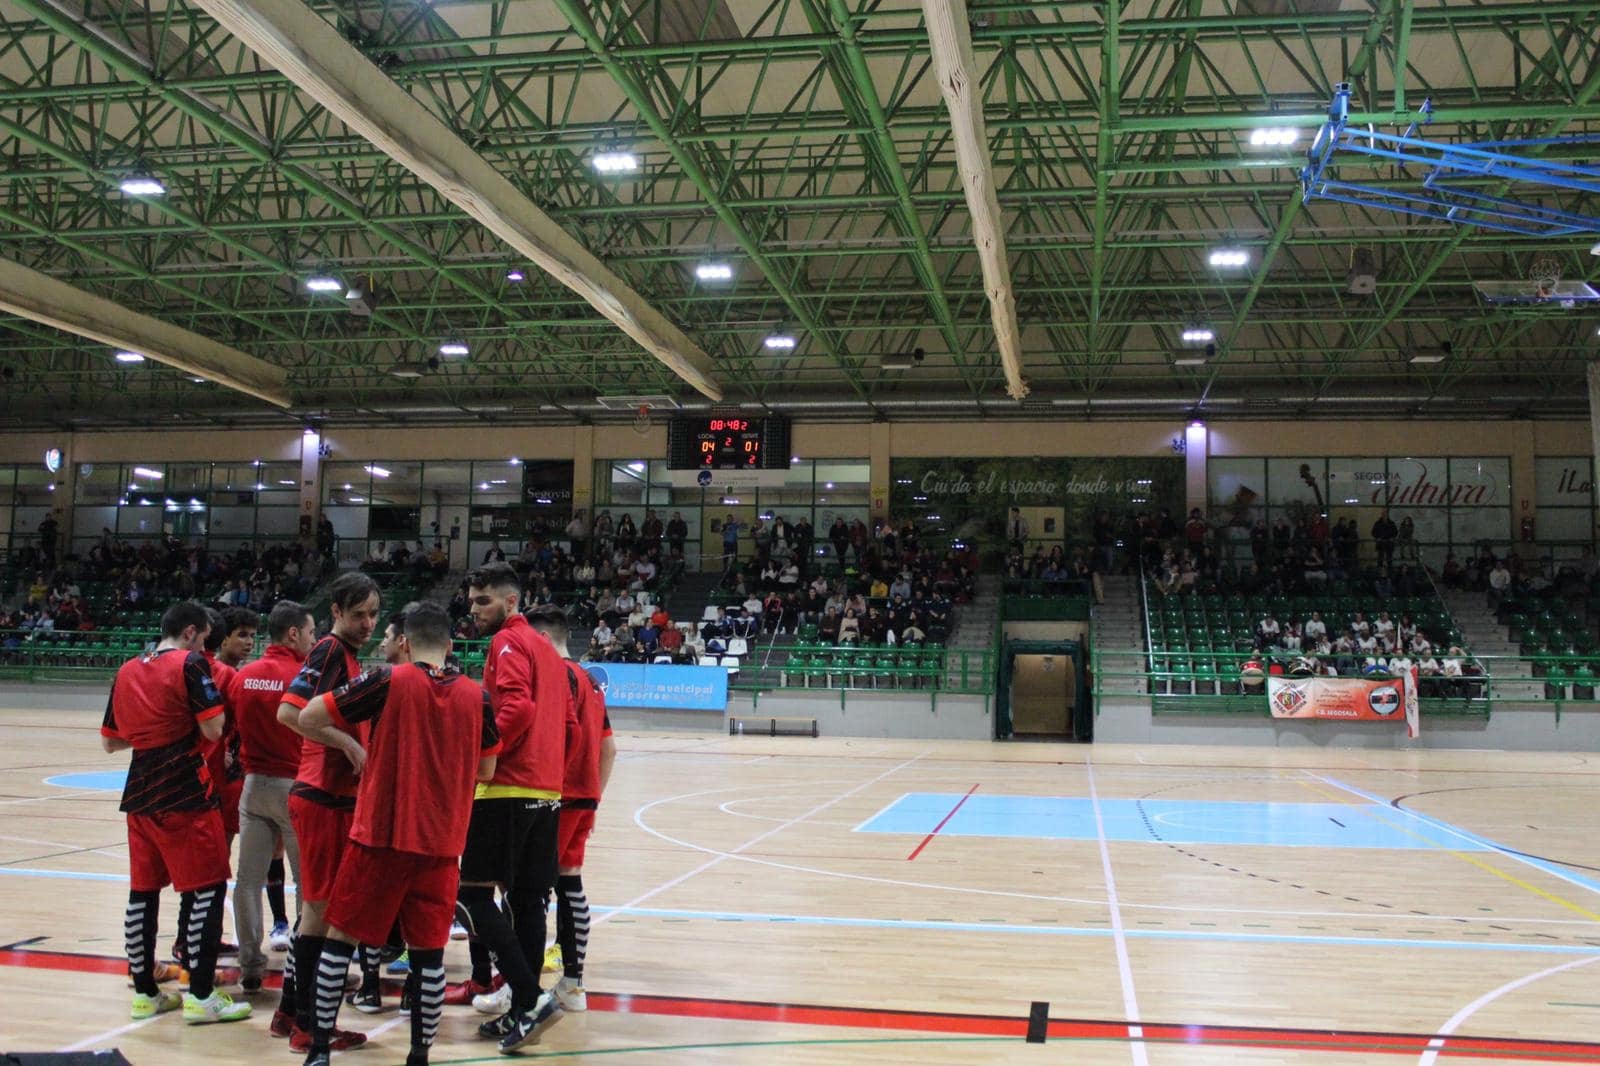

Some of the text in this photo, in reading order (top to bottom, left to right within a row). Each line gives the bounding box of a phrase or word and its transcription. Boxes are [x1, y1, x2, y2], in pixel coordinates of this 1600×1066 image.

[710, 420, 748, 431] 08:48 2
[702, 441, 715, 452] 04
[725, 437, 732, 447] 2
[745, 441, 759, 452] 01
[705, 455, 712, 464] 2
[749, 455, 756, 464] 2
[920, 470, 972, 494] Cuida
[978, 470, 996, 494] el
[1000, 479, 1056, 502] espacio
[1066, 474, 1110, 496] donde
[527, 487, 571, 500] Segovia
[243, 678, 284, 692] SEGOSALA
